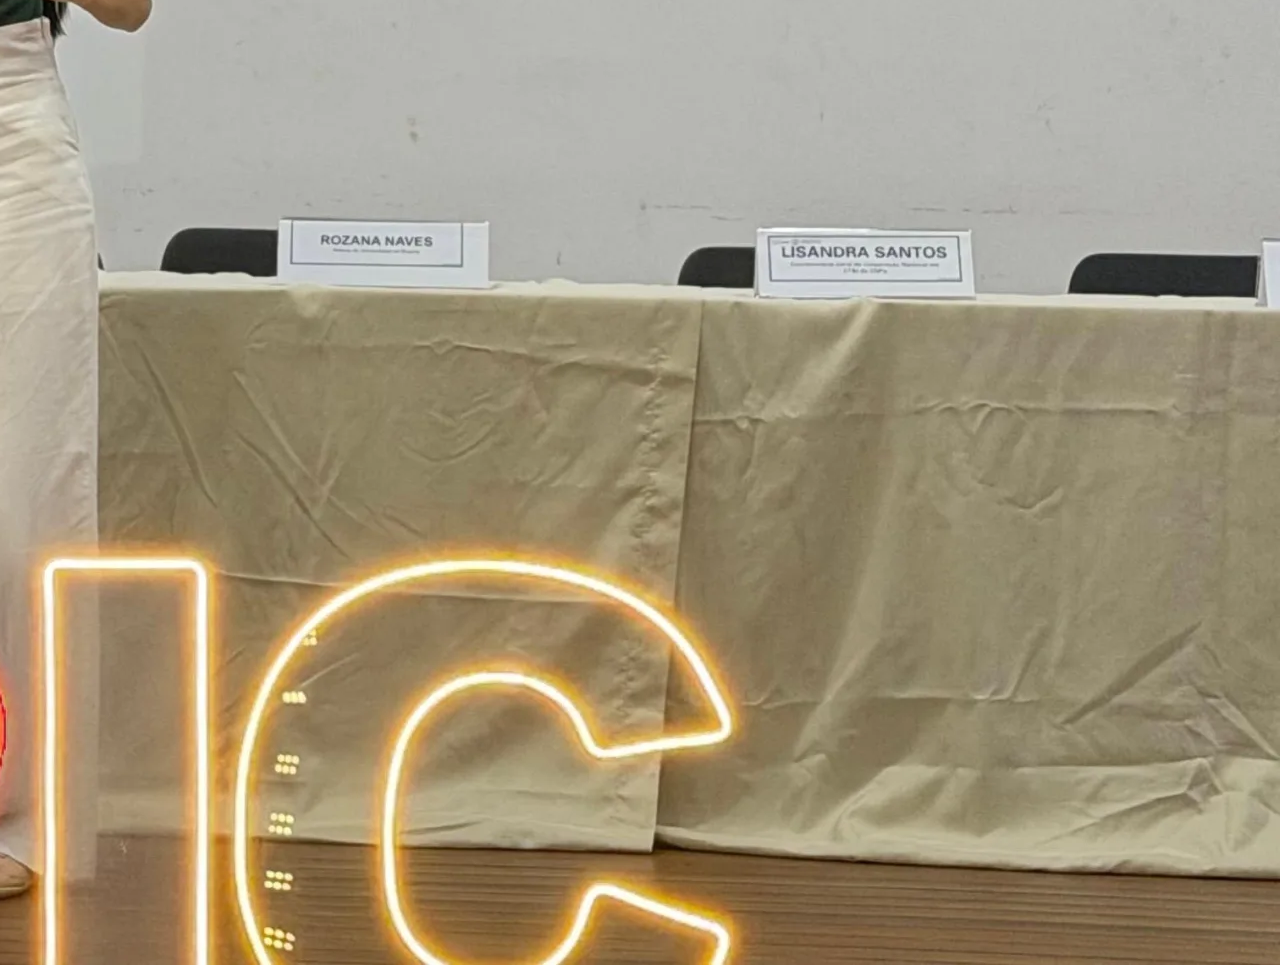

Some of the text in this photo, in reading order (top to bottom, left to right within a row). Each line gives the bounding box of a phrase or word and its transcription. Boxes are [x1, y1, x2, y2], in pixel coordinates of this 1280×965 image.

[319, 234, 434, 247] ROZANA NAVES
[781, 245, 948, 259] LISANDRA SANTOS
[38, 553, 738, 965] IC
